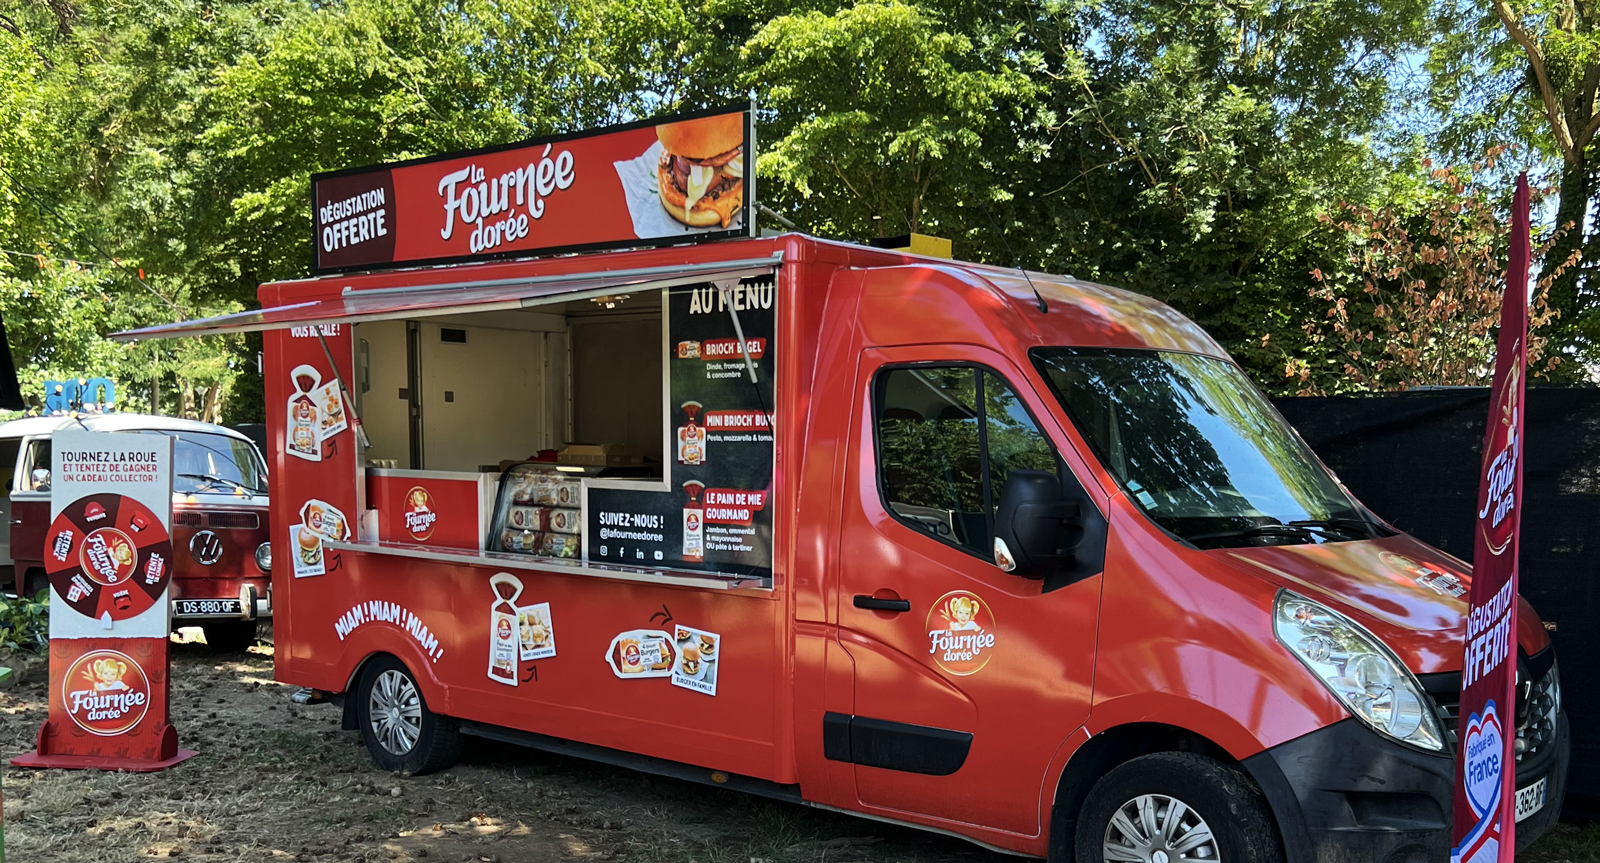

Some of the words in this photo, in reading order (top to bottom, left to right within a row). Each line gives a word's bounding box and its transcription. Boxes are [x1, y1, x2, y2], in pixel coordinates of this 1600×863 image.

[471, 163, 485, 184] la
[438, 143, 575, 240] Fournée
[320, 187, 385, 225] DÉGUSTATION
[323, 209, 387, 253] OFFERTE
[469, 209, 529, 254] dorée
[690, 288, 713, 314] AU
[719, 282, 773, 312] MENU
[291, 326, 308, 338] VOUS
[737, 341, 762, 355] BGEL
[723, 363, 745, 371] fromage
[711, 371, 741, 379] concombre
[706, 415, 723, 427] MINI
[723, 434, 752, 442] mozzarella
[61, 452, 110, 463] TOURNEZ
[113, 452, 126, 463] LA
[128, 452, 158, 463] ROUE
[63, 464, 73, 472] ET
[75, 464, 107, 473] TENTEZ
[109, 464, 120, 473] DE
[122, 464, 158, 473] GAGNER
[63, 474, 74, 482] UN
[76, 474, 108, 483] CADEAU
[109, 474, 154, 483] COLLECTOR
[706, 493, 715, 504] LE
[716, 493, 735, 505] PAIN
[735, 494, 746, 505] DE
[747, 494, 762, 505] MIE
[405, 511, 437, 529] Fournée
[599, 511, 659, 529] SUIVEZ-NOUS
[706, 508, 750, 521] GOURMAND
[600, 527, 664, 542] @lafourneedoree
[706, 526, 729, 535] Jambon,
[57, 529, 74, 563] RETENTE
[711, 535, 743, 543] mayonnaise
[706, 542, 715, 550] OU
[732, 544, 754, 552] tartiner
[87, 533, 118, 583] Fournée
[145, 552, 160, 585] RETENTE
[928, 629, 995, 655] Fournée
[640, 648, 660, 657] Burgers
[943, 648, 973, 662] dorée
[676, 676, 691, 686] BURGER
[69, 688, 146, 715] Fournée
[87, 707, 121, 721] dorée
[1487, 733, 1496, 747] en
[1468, 753, 1499, 788] France
